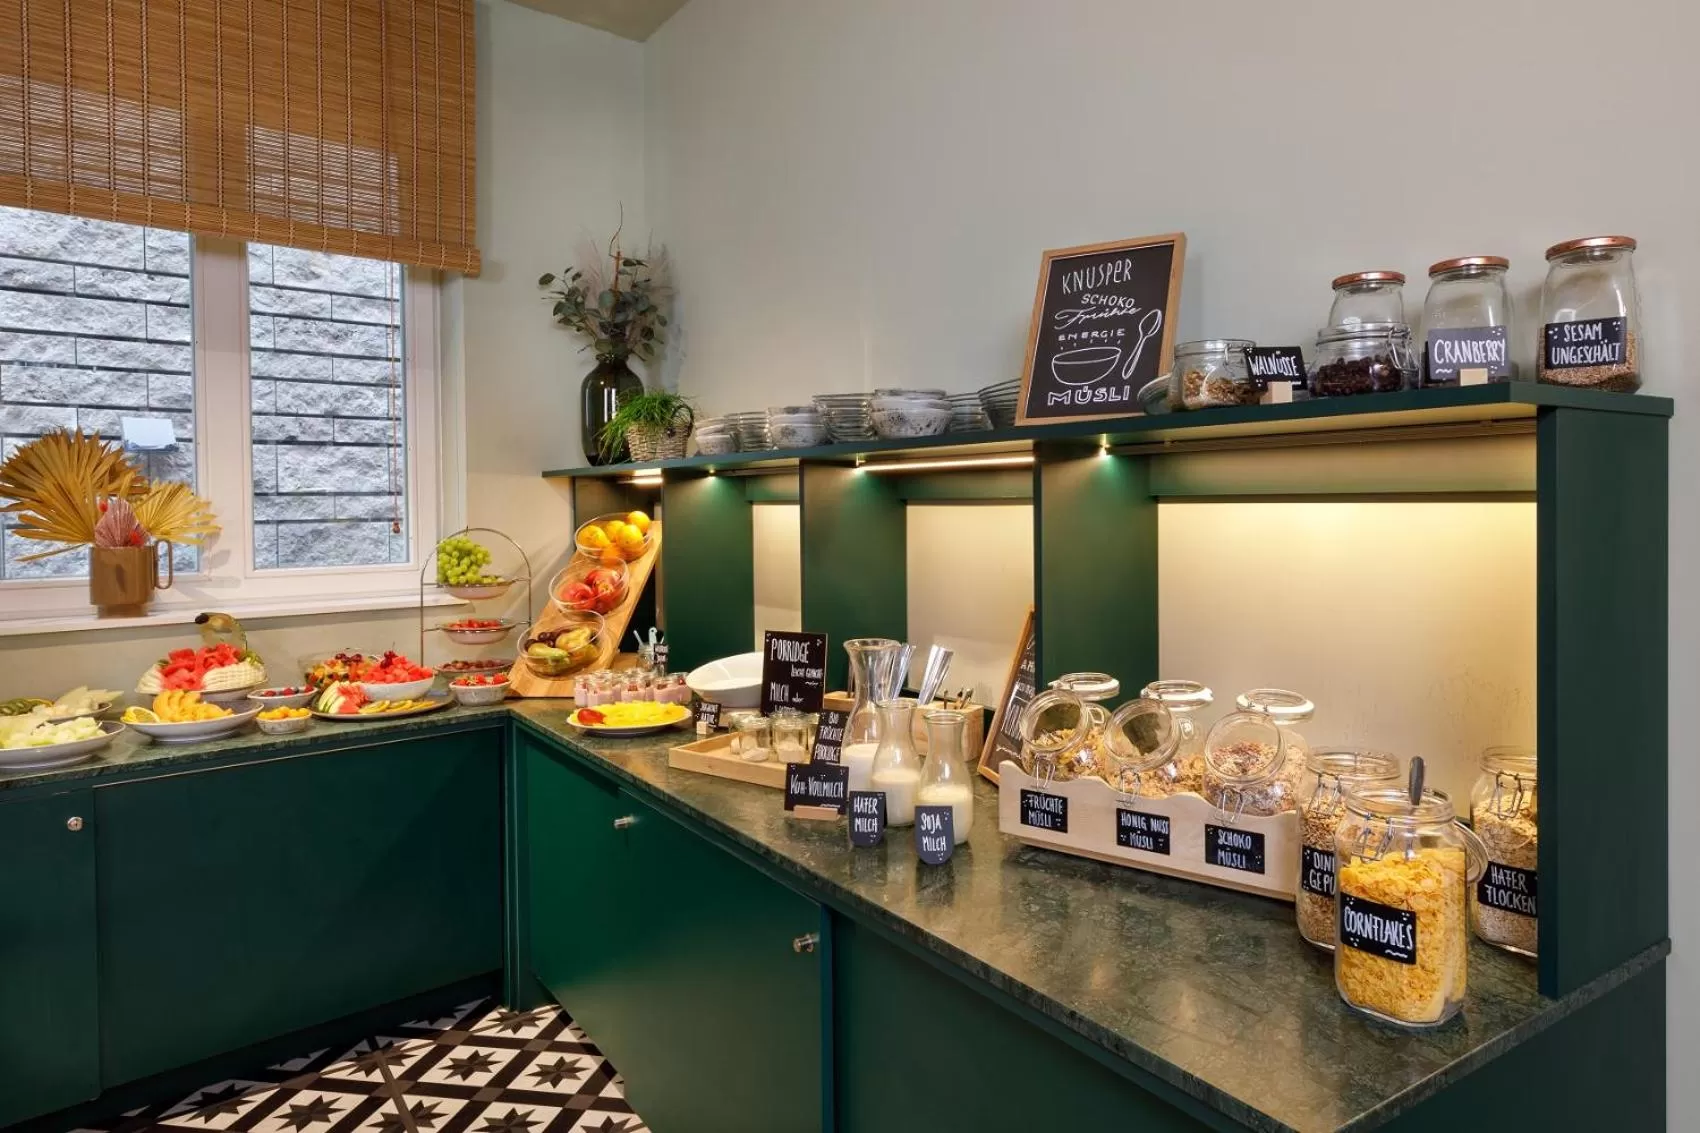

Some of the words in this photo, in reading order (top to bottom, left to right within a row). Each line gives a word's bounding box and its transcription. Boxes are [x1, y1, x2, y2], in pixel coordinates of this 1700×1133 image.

[1081, 293, 1135, 308] SCHOKO
[1058, 328, 1126, 341] ENERGIE
[1563, 322, 1602, 343] SESAM
[1433, 338, 1506, 366] CRANBERRY
[1551, 339, 1621, 365] UNGESCHÄLT
[1250, 350, 1300, 377] WALNÜSSE
[1047, 385, 1131, 406] MÜSLI
[771, 638, 810, 664] PORRIDGE
[769, 681, 790, 702] MILCH
[853, 796, 878, 815] HAFER
[1027, 793, 1063, 815] FRÜCHTE
[854, 817, 878, 833] MILCH
[921, 812, 942, 834] SOJA
[1028, 810, 1051, 828] MÜSLI
[1121, 812, 1147, 829] HONIG
[1150, 816, 1169, 834] NUSS
[922, 836, 947, 852] MILCH
[1129, 831, 1154, 850] MÜSLI
[1217, 831, 1251, 850] SCHOKO
[1217, 848, 1246, 869] MÜSLI
[1490, 866, 1528, 893] HAFER
[1484, 883, 1537, 915] FLOCKEN
[1343, 905, 1414, 950] CORNFLAKES
